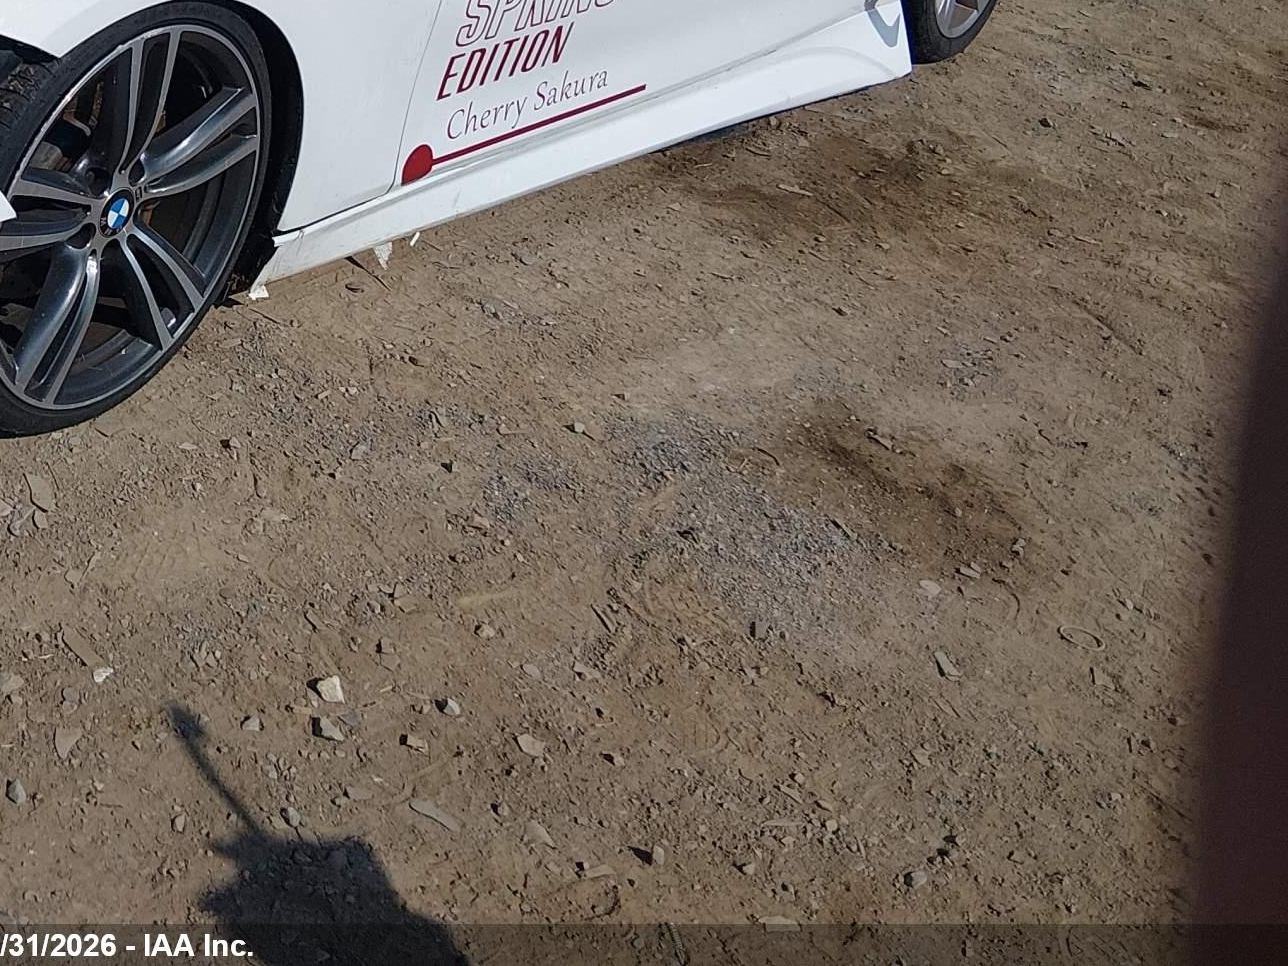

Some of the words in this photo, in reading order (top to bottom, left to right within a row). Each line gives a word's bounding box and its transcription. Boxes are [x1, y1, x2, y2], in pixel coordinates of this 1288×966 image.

[435, 21, 575, 101] EDITION
[446, 99, 527, 140] Cherry
[533, 68, 609, 111] Sakura
